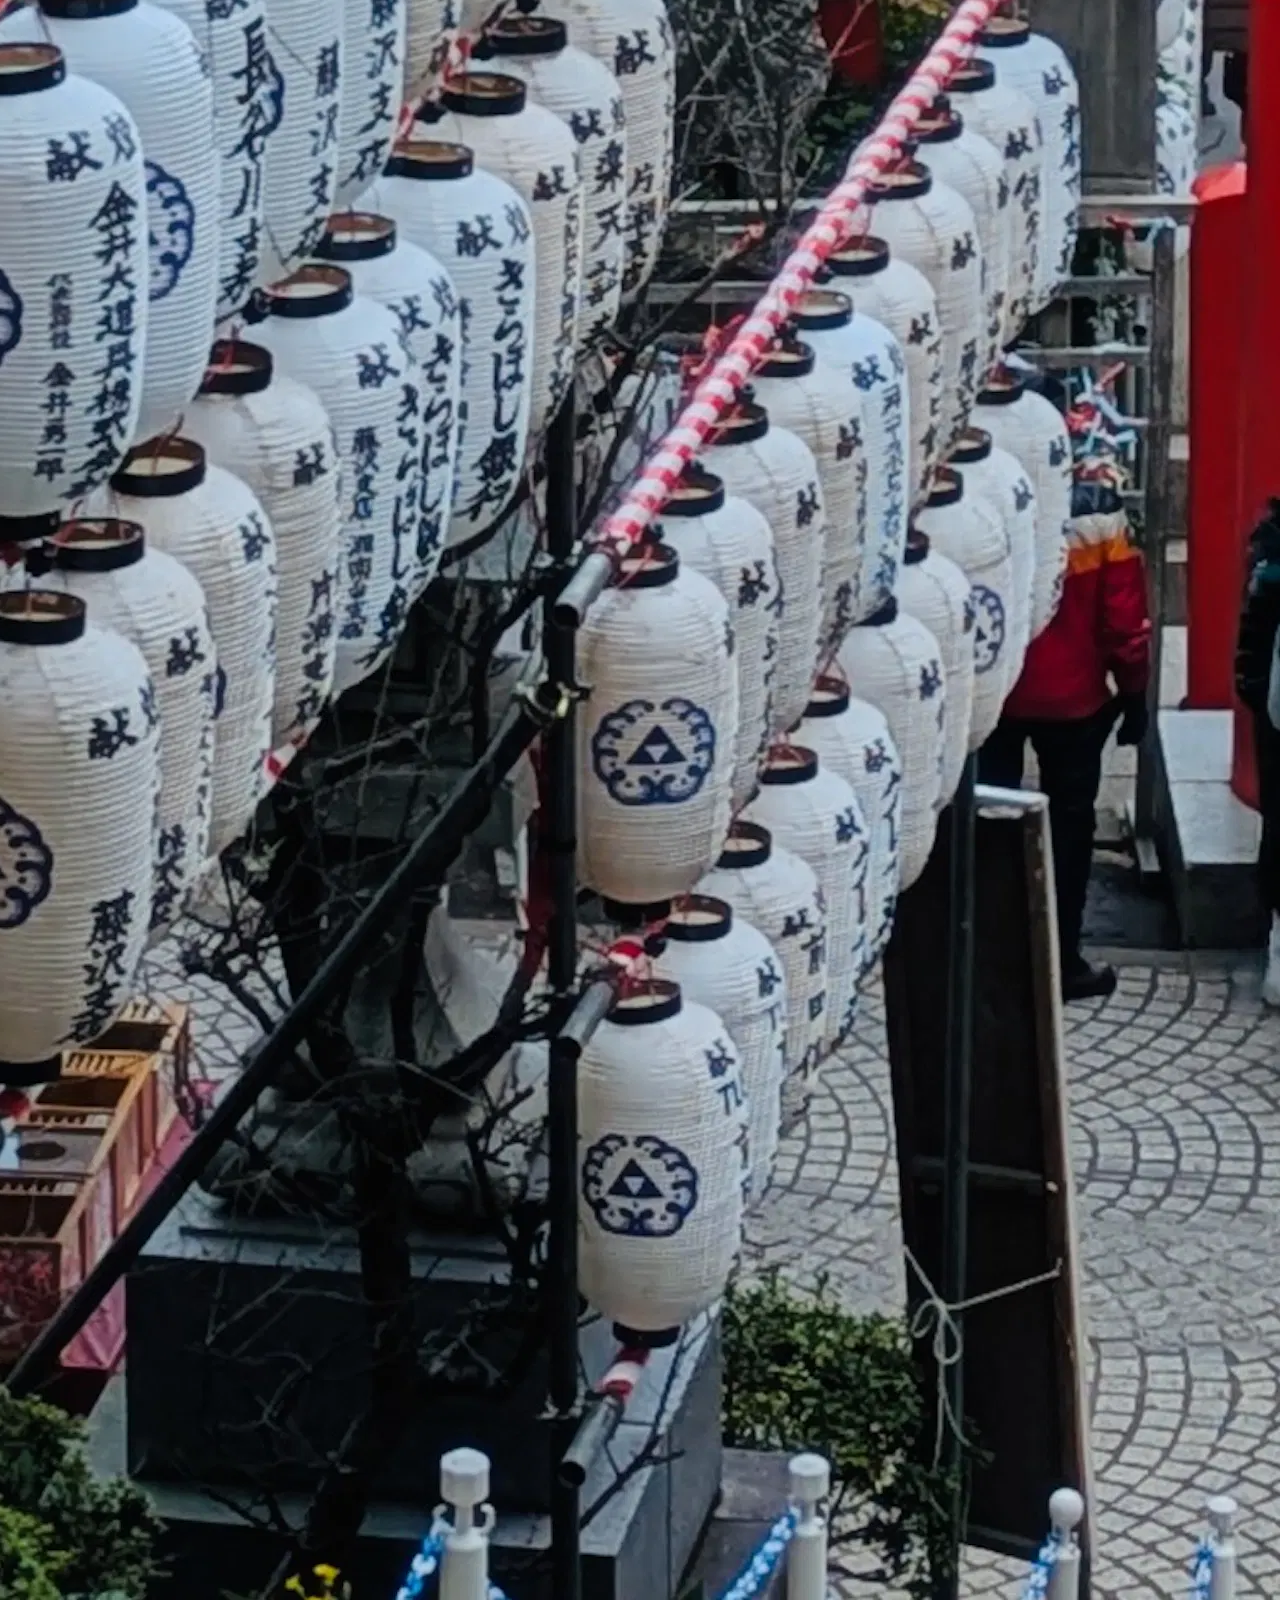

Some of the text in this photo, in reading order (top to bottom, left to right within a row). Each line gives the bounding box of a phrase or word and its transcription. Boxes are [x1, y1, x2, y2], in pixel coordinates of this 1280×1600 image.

[454, 258, 528, 524] きらぼし銀行
